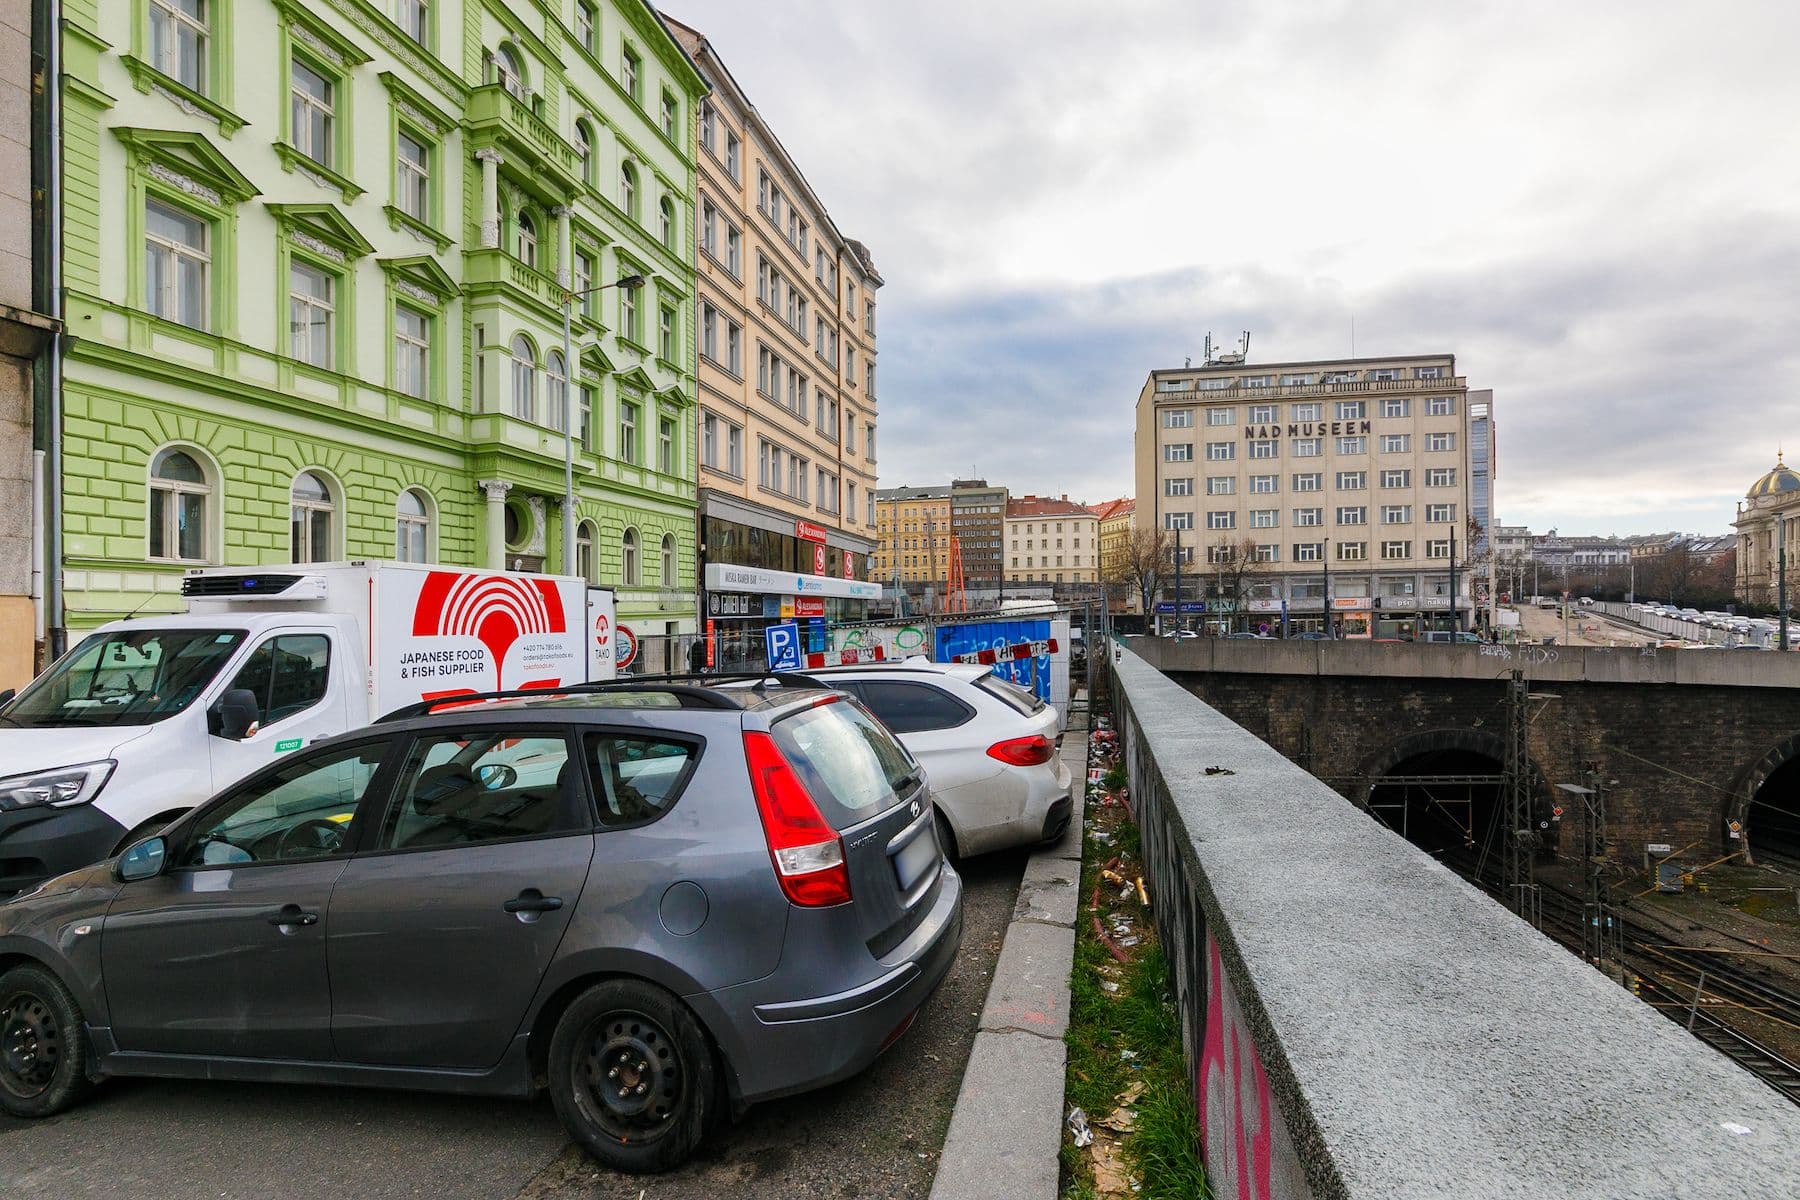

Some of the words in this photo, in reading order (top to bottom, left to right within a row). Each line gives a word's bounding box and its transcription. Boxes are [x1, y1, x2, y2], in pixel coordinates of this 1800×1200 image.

[1245, 425, 1281, 439] NAD
[1288, 421, 1371, 437] MUSEEM
[771, 630, 790, 656] P
[400, 651, 454, 664] JAPANESE
[457, 650, 484, 660] FOOD
[595, 648, 610, 660] TAKO
[401, 668, 408, 679] &
[412, 666, 435, 678] FISH
[439, 662, 484, 675] SUPPLIER
